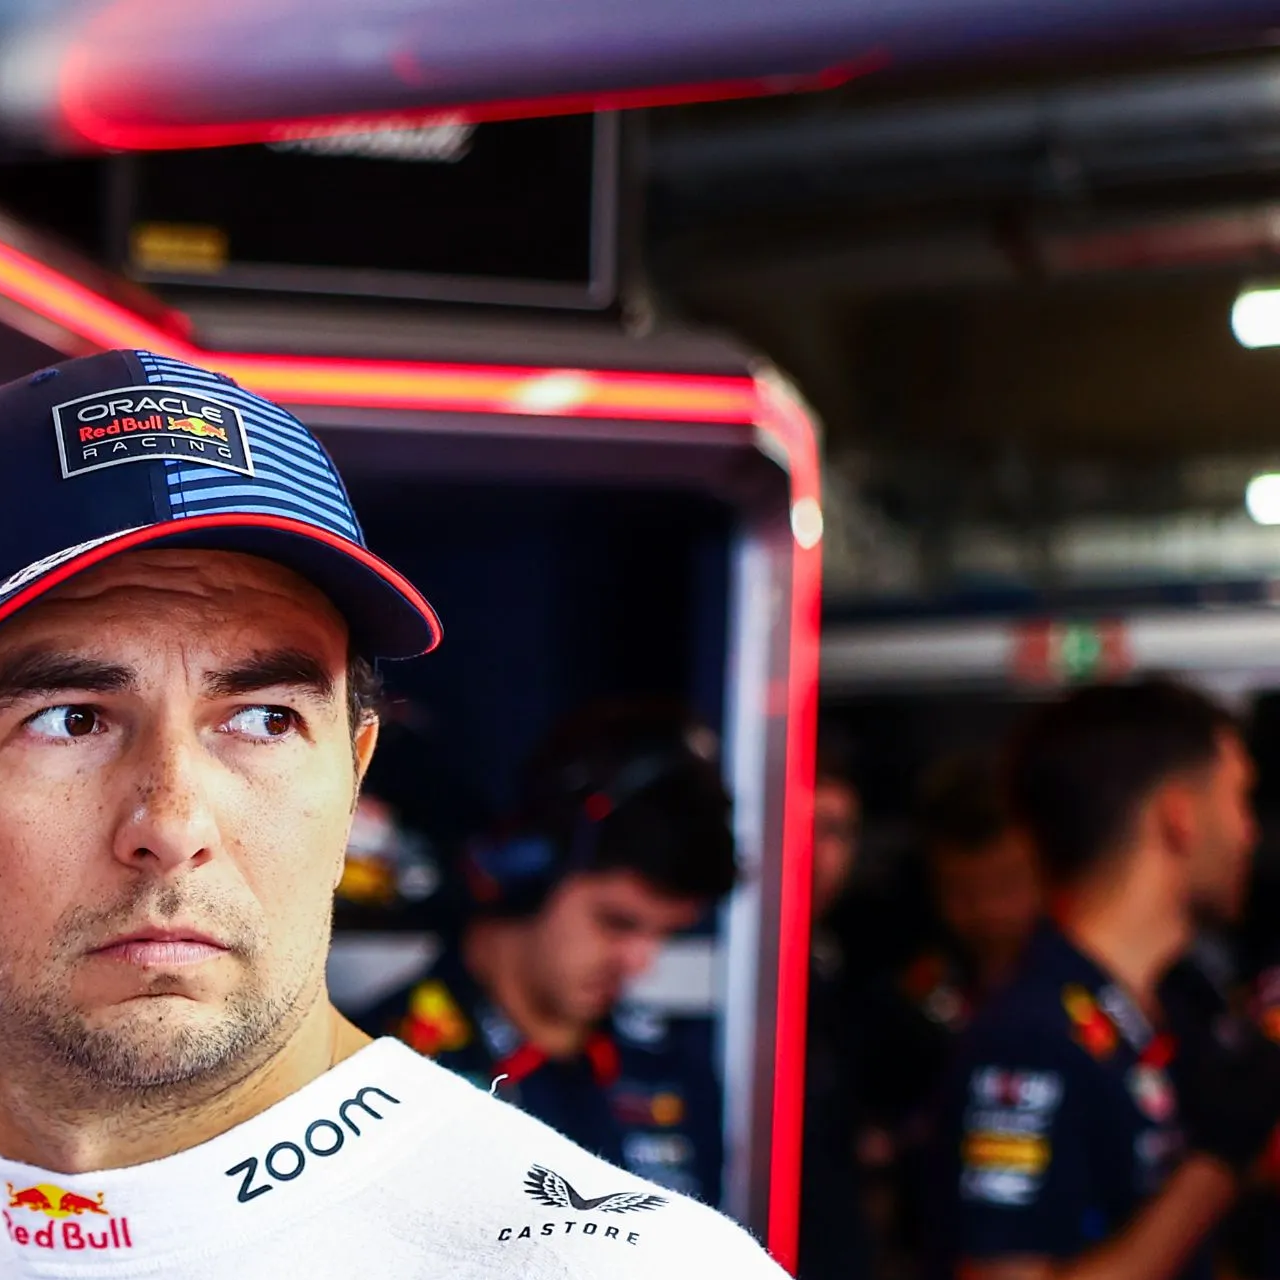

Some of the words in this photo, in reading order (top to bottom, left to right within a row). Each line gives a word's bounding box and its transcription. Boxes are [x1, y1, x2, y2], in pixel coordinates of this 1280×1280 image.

[77, 396, 224, 425] ORACLE
[79, 419, 120, 442] Red
[122, 415, 163, 433] Bull
[83, 437, 232, 460] RACING
[225, 1086, 401, 1204] zoom
[62, 1217, 132, 1250] Bull
[497, 1221, 640, 1246] CASTORE
